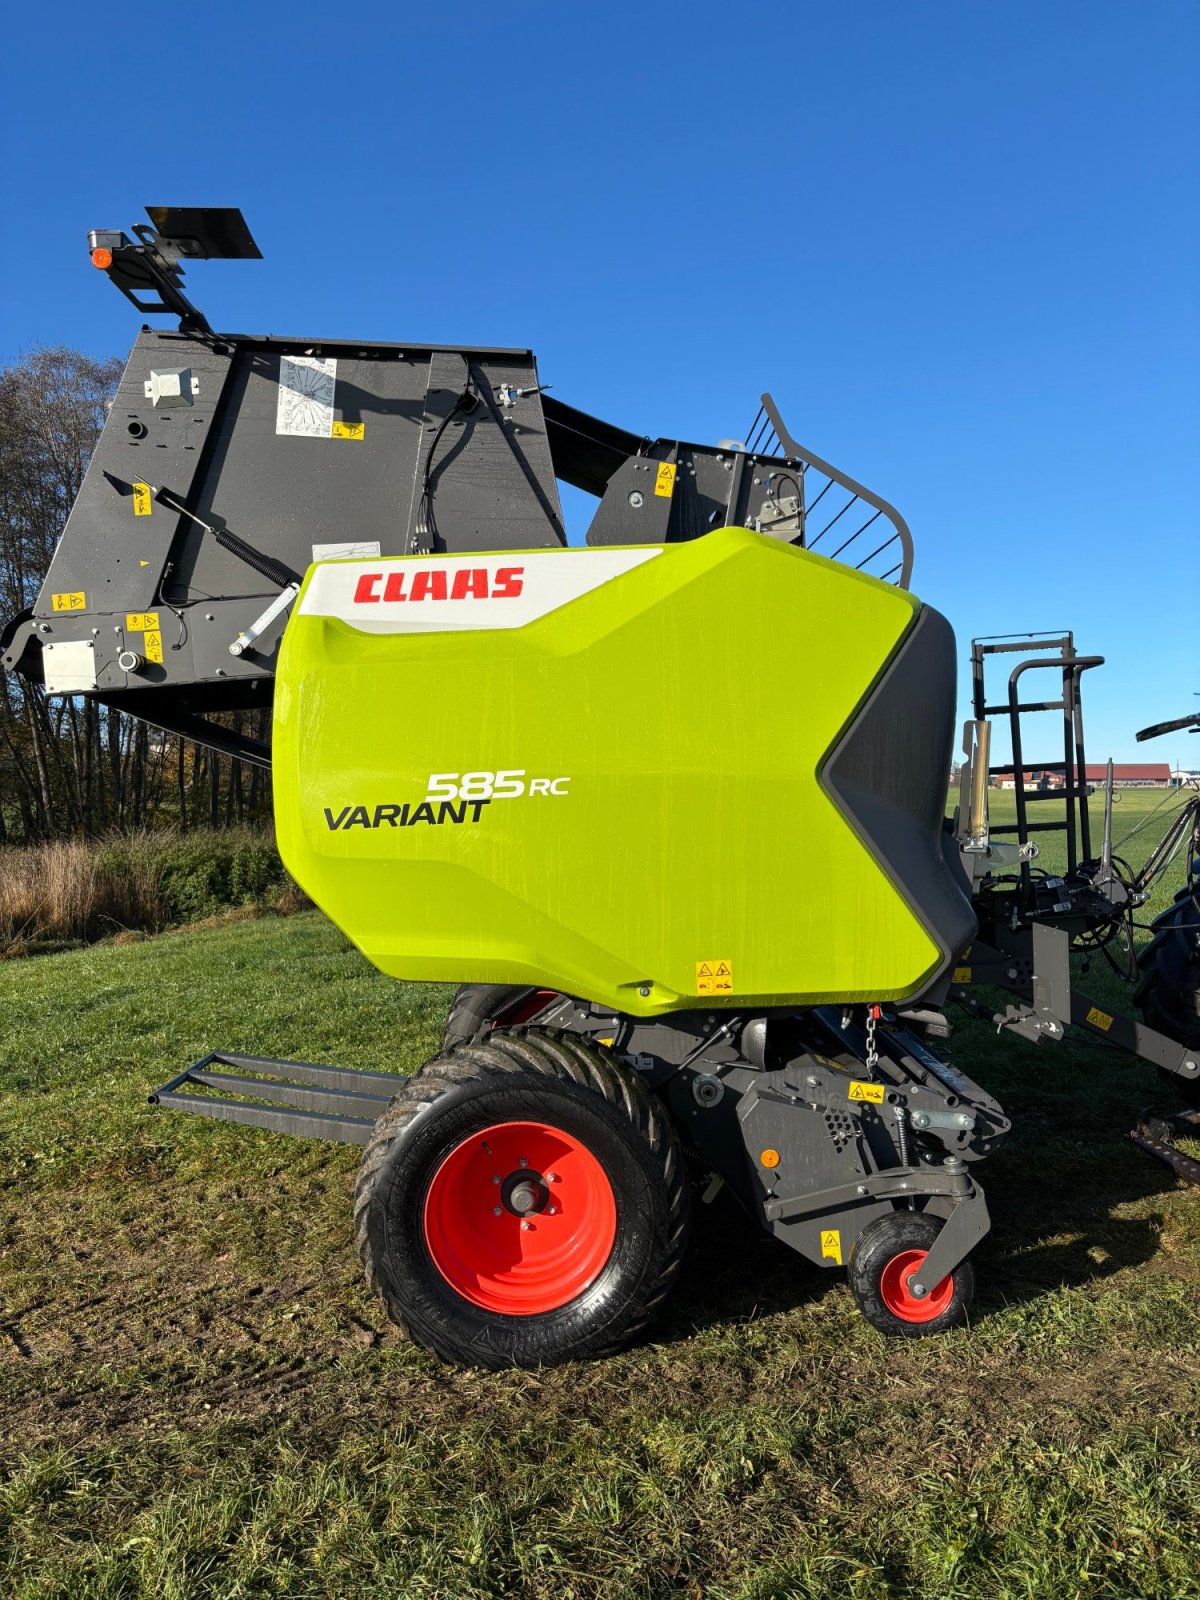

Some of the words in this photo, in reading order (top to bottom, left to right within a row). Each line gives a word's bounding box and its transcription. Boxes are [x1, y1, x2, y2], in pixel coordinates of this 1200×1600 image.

[354, 567, 525, 603] CLAAS
[425, 769, 526, 802] 585
[528, 777, 571, 797] RC
[323, 799, 491, 831] VARIANT
